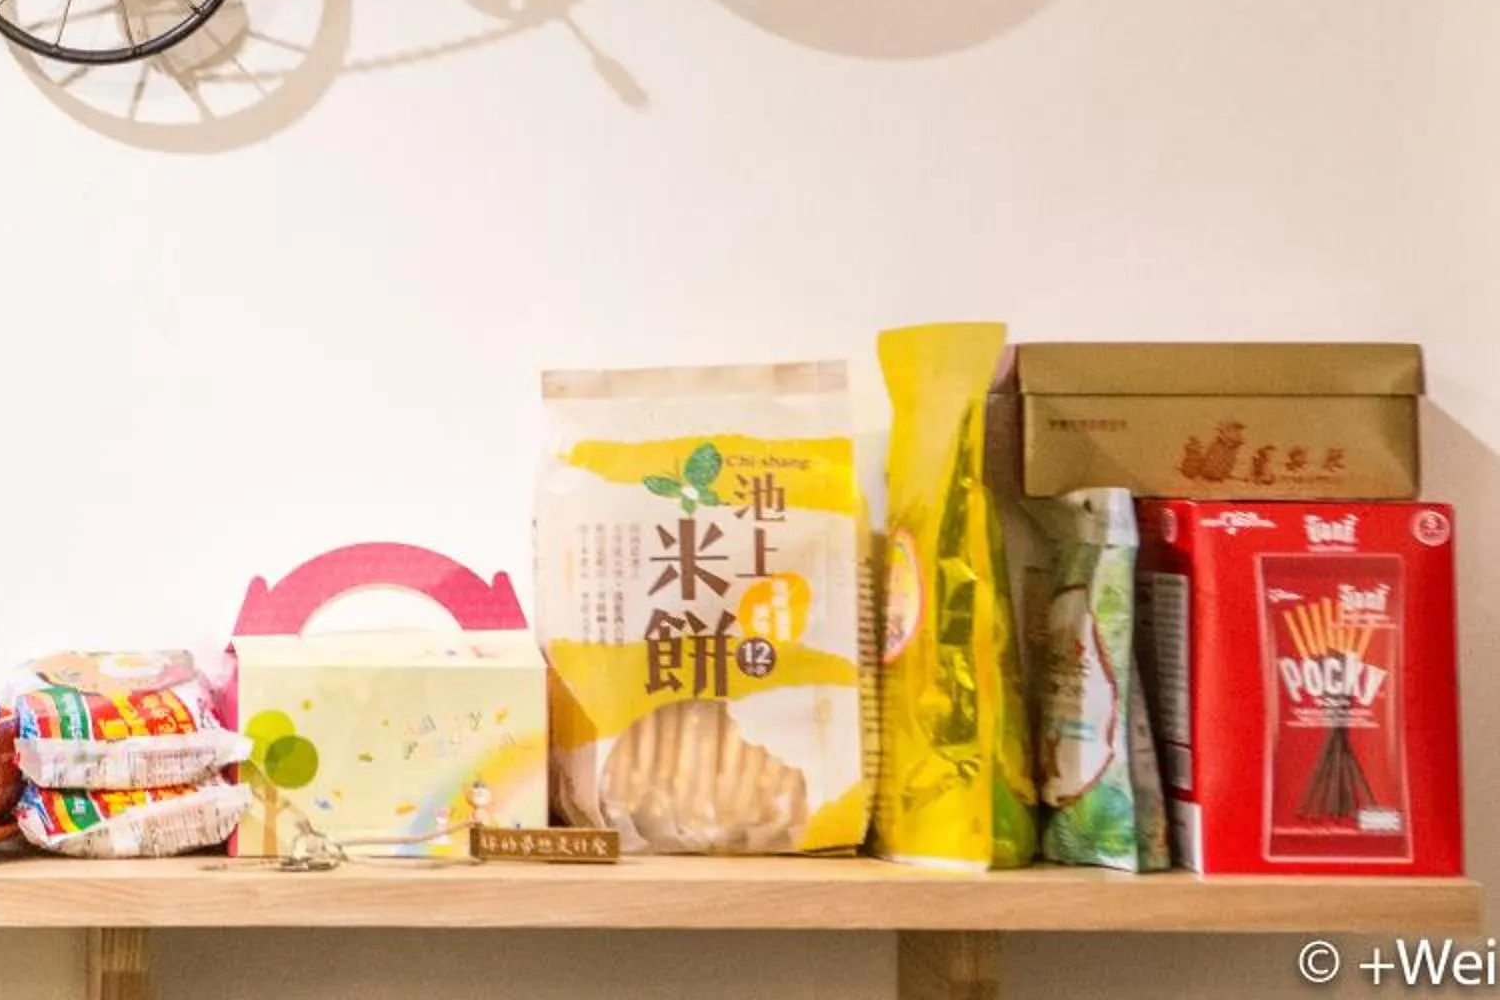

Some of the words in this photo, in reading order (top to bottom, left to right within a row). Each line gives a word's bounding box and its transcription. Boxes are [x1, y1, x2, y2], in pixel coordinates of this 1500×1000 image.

[734, 473, 786, 577] 池上
[644, 519, 737, 697] 米餅
[741, 641, 773, 664] 12
